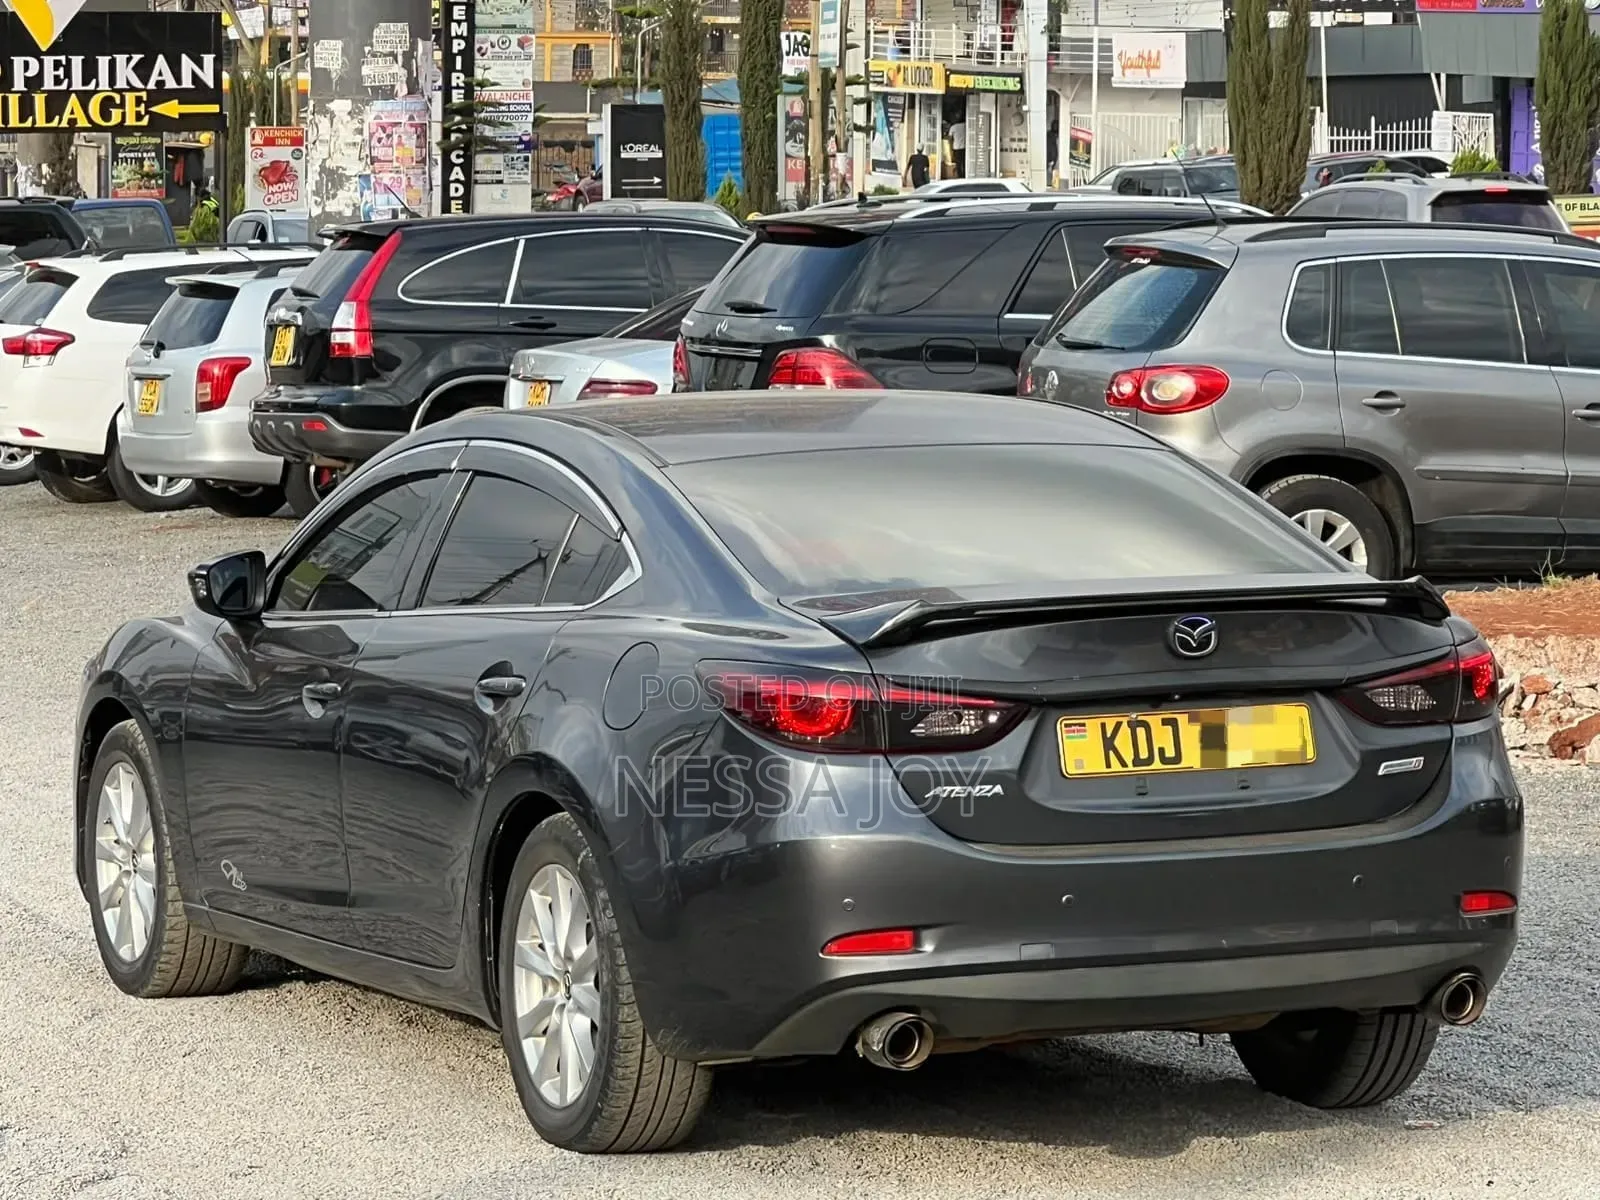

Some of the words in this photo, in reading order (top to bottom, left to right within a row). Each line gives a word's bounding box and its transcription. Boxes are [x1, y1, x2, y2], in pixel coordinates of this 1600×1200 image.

[450, 5, 468, 103] EMPIRE
[1117, 49, 1160, 78] Youthful
[10, 53, 216, 91] PELIKAN
[475, 92, 532, 102] AVALANCHE
[0, 91, 150, 128] LLAGE
[264, 129, 303, 137] KENCHICK
[268, 183, 294, 195] NOW
[264, 190, 298, 205] OPEN
[1564, 203, 1578, 211] OF
[1100, 717, 1183, 769] KDJ
[924, 784, 1005, 798] ATENZA
